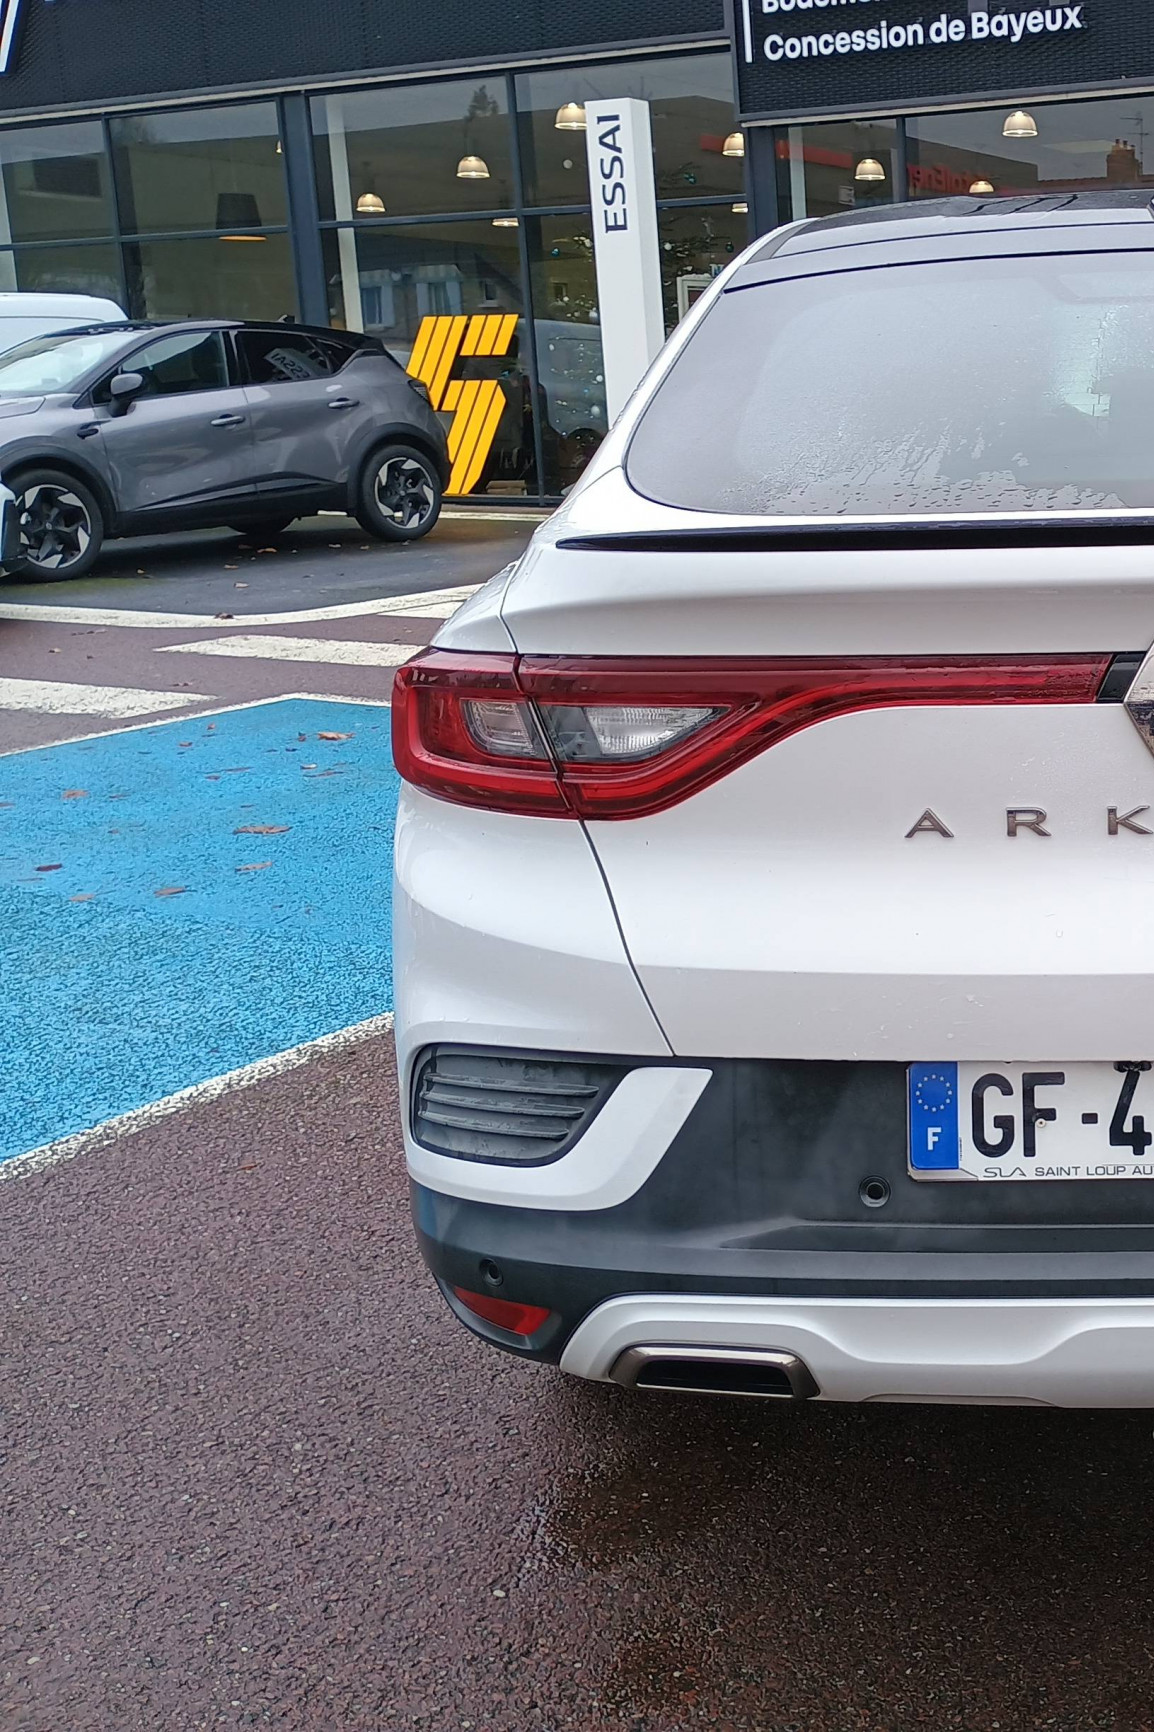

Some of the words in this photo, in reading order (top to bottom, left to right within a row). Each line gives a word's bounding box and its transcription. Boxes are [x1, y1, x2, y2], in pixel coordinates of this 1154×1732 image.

[763, 20, 924, 61] Concession
[929, 14, 966, 42] de
[970, 5, 1083, 43] Bayeux
[596, 114, 628, 234] ESSAI
[927, 1127, 942, 1150] F
[983, 1166, 1027, 1178] SLA
[1034, 1166, 1081, 1177] SAINT
[1086, 1165, 1127, 1176] LOUP
